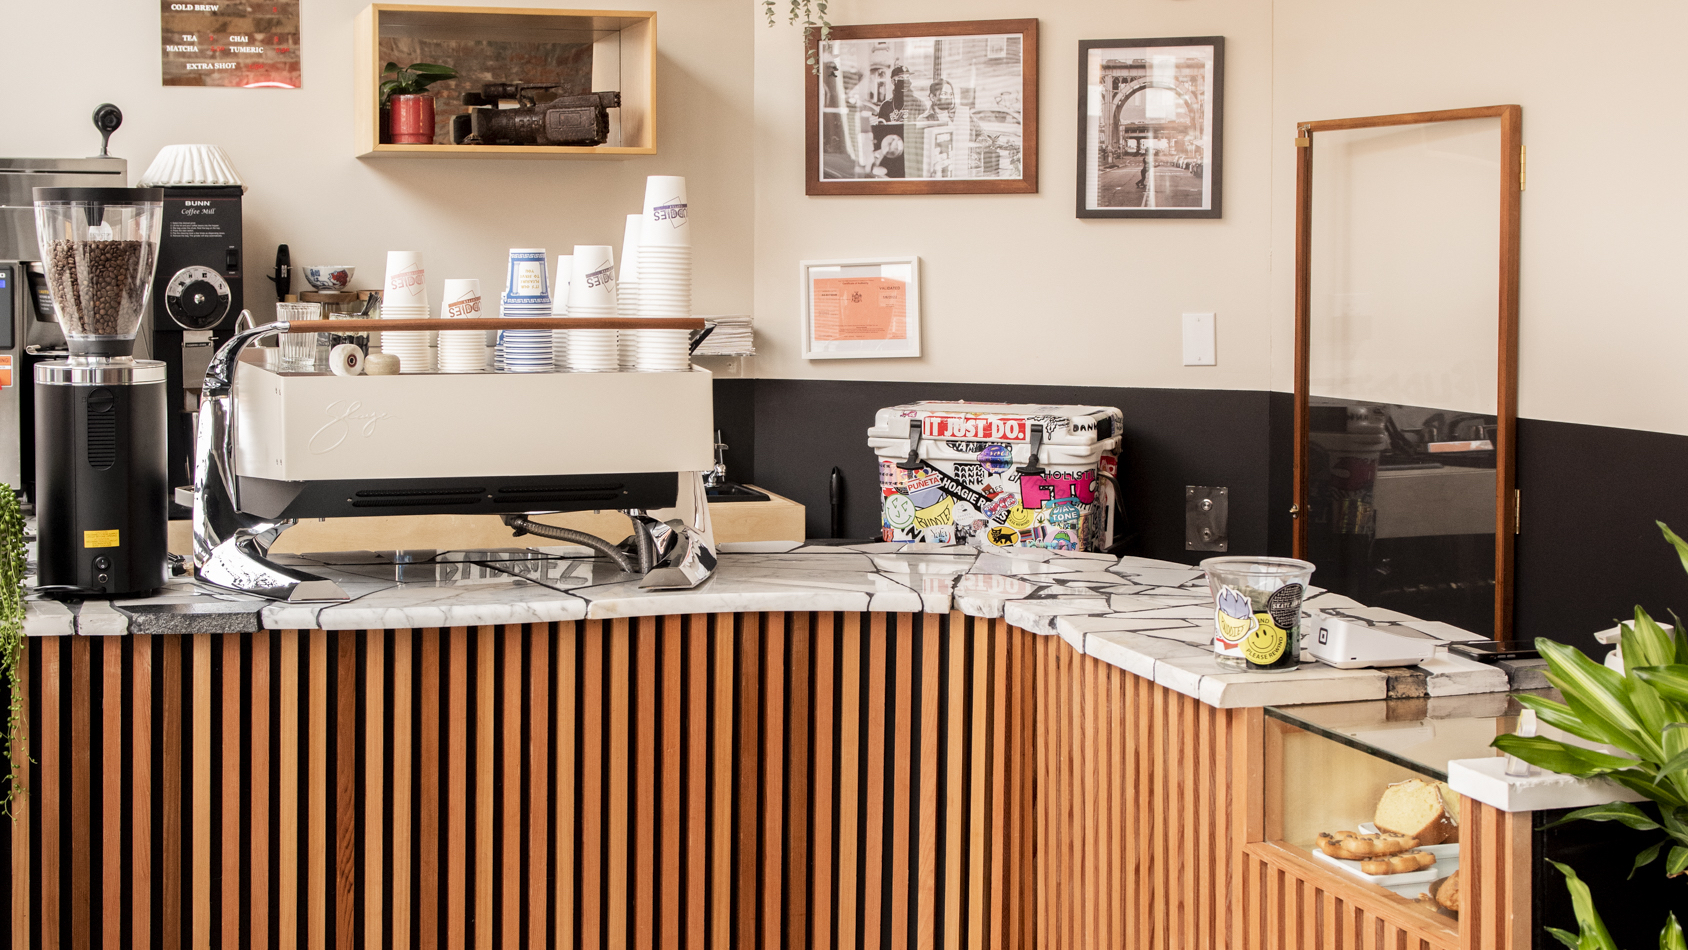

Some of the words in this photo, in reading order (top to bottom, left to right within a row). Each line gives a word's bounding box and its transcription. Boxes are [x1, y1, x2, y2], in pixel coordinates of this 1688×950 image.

[229, 46, 264, 54] TUMERIC
[181, 208, 200, 216] Coffee
[654, 208, 688, 221] UDDIES
[924, 417, 941, 436] IT
[944, 418, 986, 438] JUST
[990, 419, 1025, 439] DO.
[942, 477, 979, 504] HOAGIE
[1053, 505, 1076, 513] DIAL
[1052, 512, 1078, 521] TONE
[1246, 648, 1268, 660] PLEASE
[1268, 636, 1284, 657] REWIND
